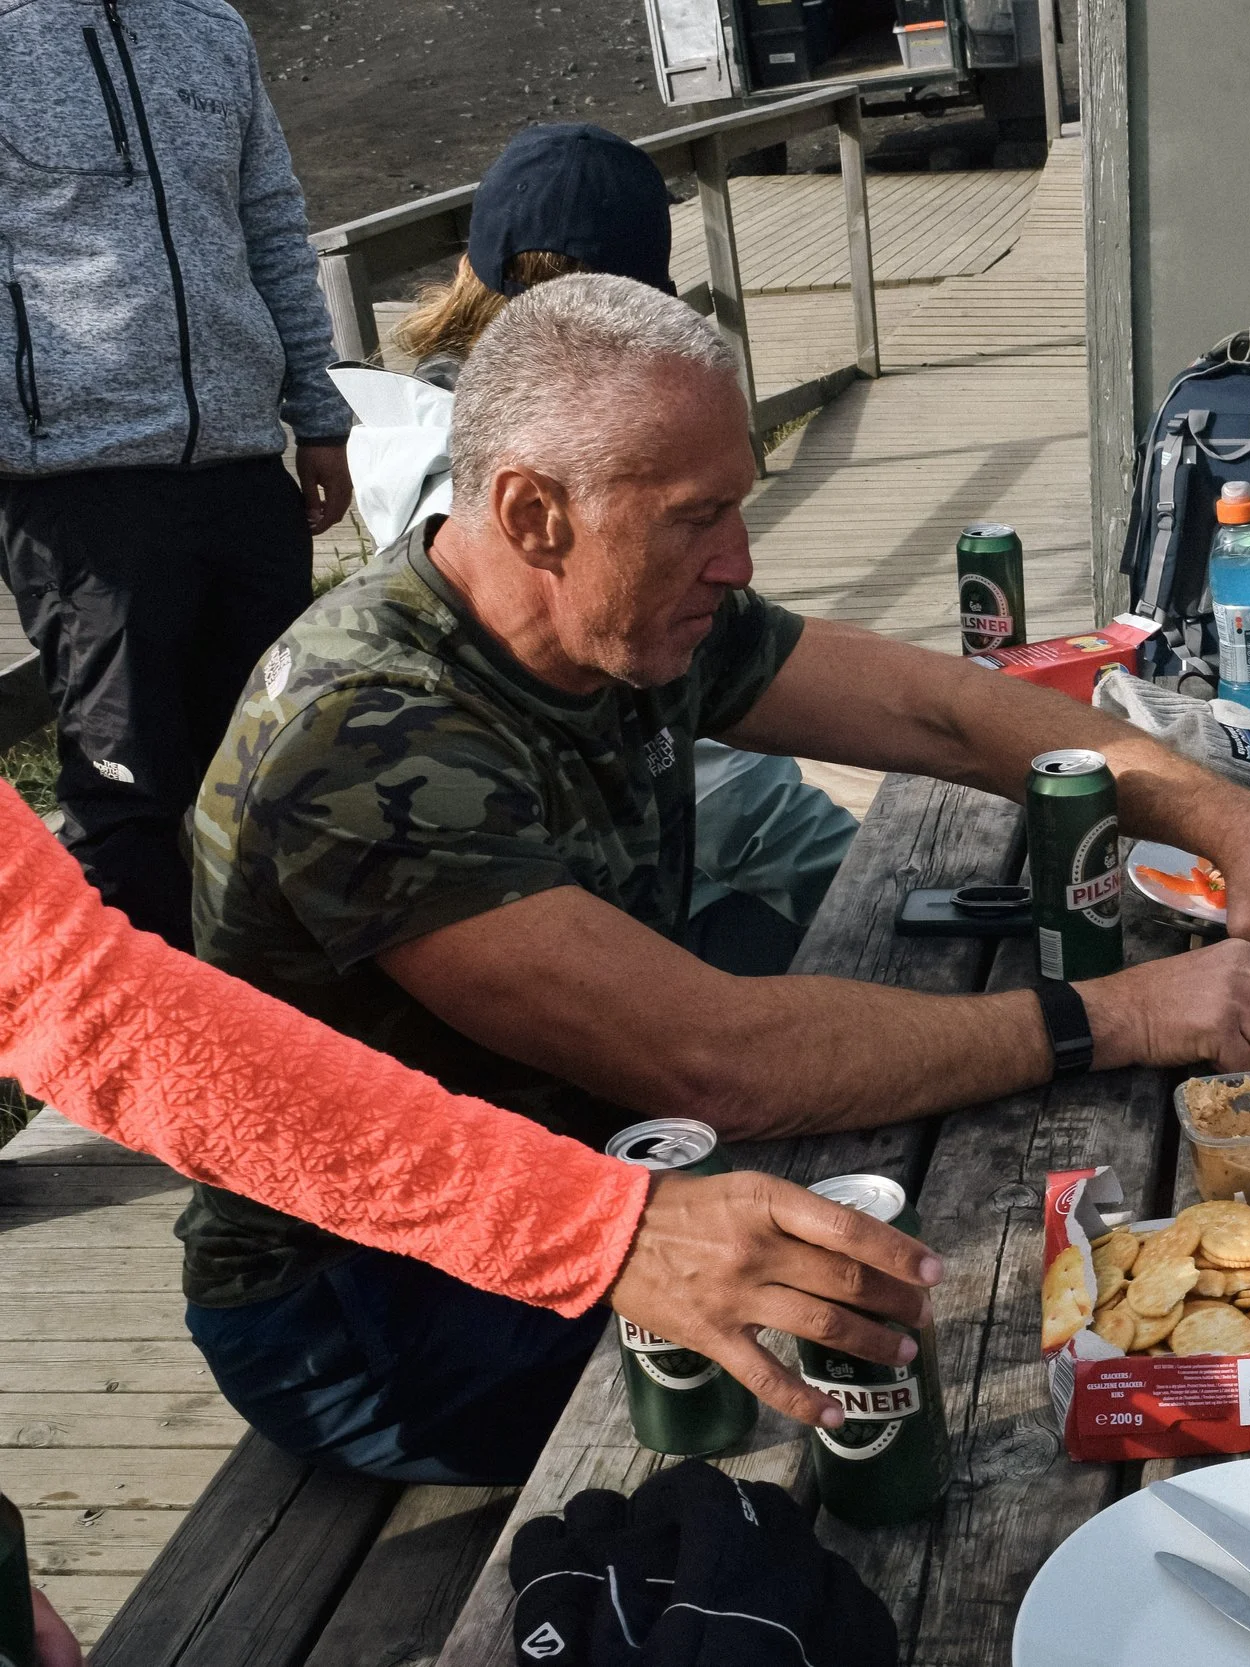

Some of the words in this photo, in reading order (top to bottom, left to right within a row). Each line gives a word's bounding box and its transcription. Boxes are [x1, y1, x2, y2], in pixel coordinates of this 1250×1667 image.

[1086, 1382, 1118, 1391] GESALZENE
[1118, 1381, 1143, 1389] CRACKER
[1110, 1412, 1132, 1425] 200
[1134, 1413, 1143, 1426] g
